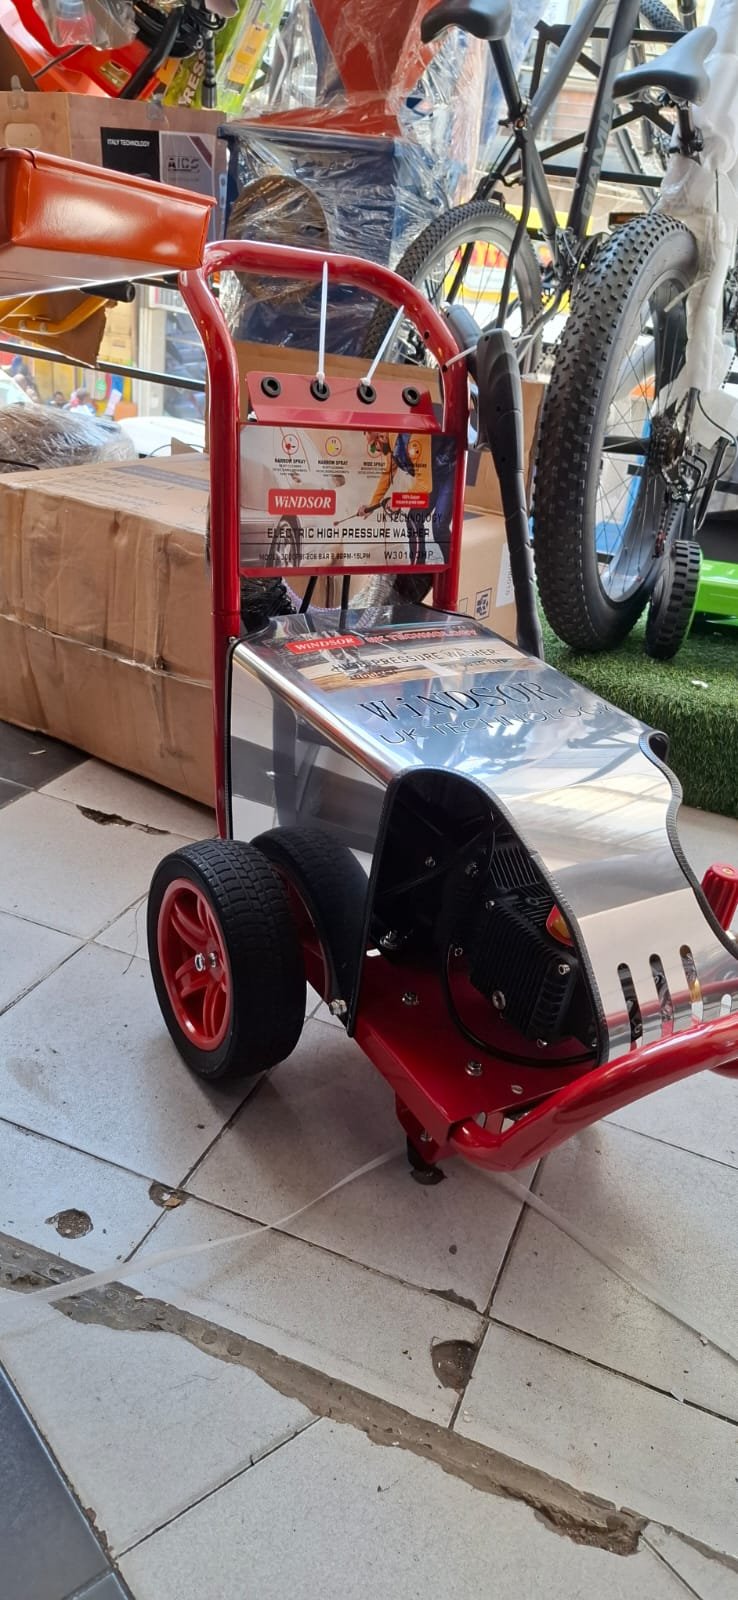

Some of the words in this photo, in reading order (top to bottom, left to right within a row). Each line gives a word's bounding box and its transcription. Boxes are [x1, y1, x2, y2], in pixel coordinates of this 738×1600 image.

[107, 138, 119, 146] ITALY
[120, 139, 150, 148] TECHNOLOGY
[317, 527, 340, 539] HIGH
[342, 527, 391, 539] PRESSURE
[393, 527, 430, 539] WASHER
[371, 651, 442, 665] PRESSURE
[444, 648, 497, 660] WASHER
[380, 727, 417, 744] UK
[432, 704, 613, 737] TECHNOLOGY
